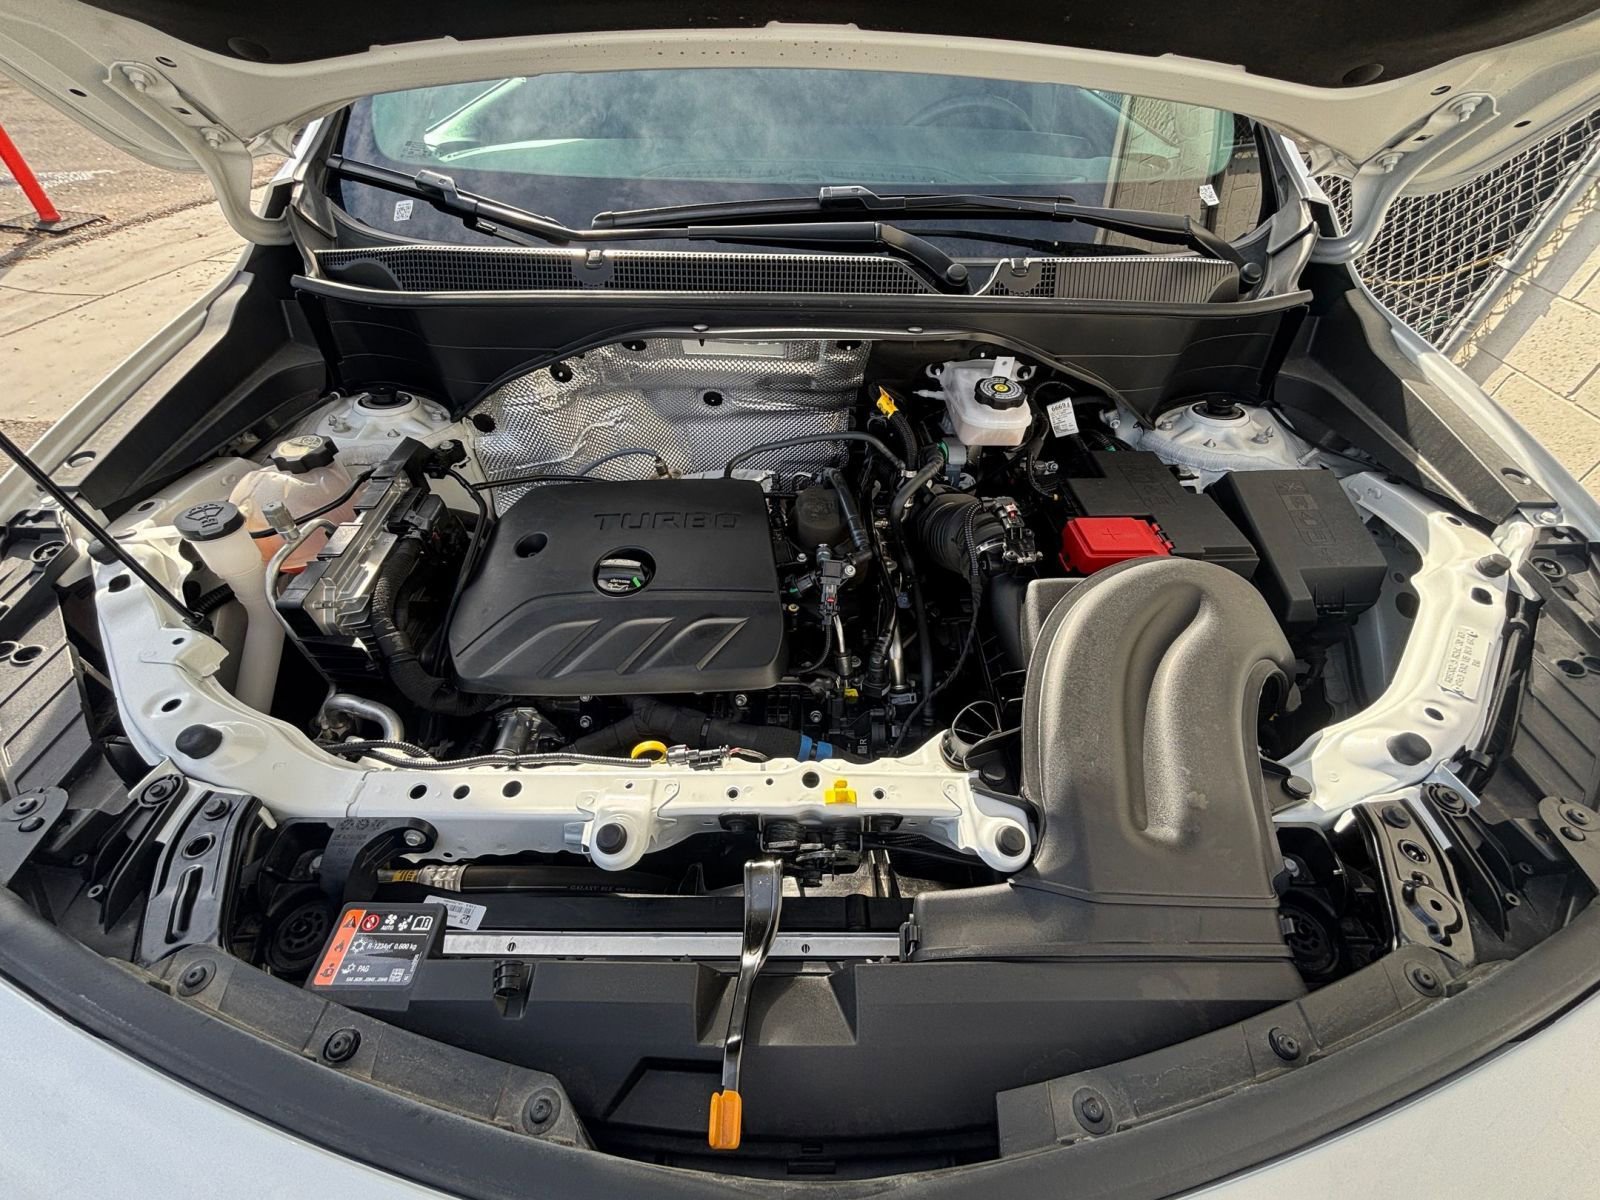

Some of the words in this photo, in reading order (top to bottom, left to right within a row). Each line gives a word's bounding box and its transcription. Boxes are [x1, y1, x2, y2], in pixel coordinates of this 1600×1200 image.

[594, 512, 740, 530] TURBO
[409, 943, 418, 951] kg
[357, 964, 370, 973] PAG
